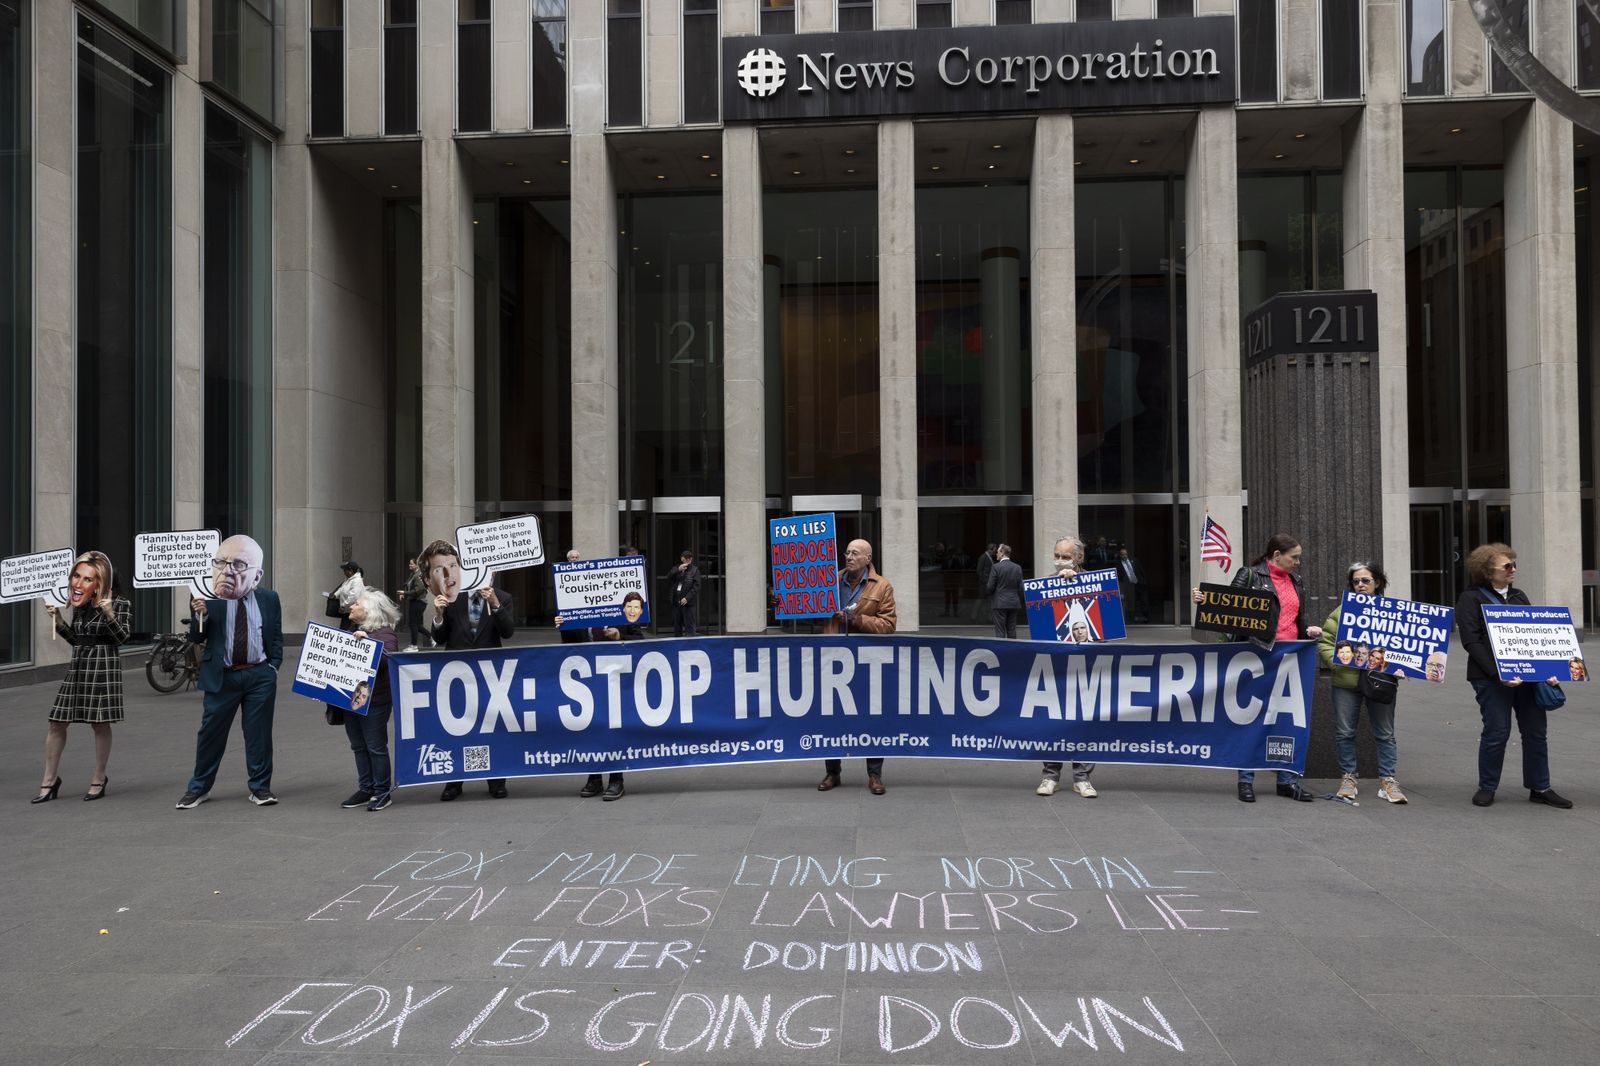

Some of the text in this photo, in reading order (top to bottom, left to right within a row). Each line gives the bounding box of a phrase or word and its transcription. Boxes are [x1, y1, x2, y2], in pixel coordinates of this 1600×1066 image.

[797, 38, 1221, 95] News Corporation
[1292, 305, 1364, 344] 1211
[485, 534, 500, 542] able
[509, 529, 532, 539] ignore
[499, 522, 516, 531] close
[775, 521, 827, 538] FOX LIES
[148, 542, 207, 553] disgusted by
[467, 544, 496, 554] Trump
[512, 538, 532, 547] hate
[772, 538, 836, 565] MURDOCH
[18, 557, 44, 566] serious
[45, 552, 70, 562] lawyer
[142, 554, 173, 562] Trump
[179, 559, 207, 568] scared
[463, 557, 480, 566] him
[554, 558, 643, 571] Tucker's producer:
[2, 560, 70, 577] could believe what
[560, 568, 638, 584] [Our viewers are]
[774, 564, 837, 590] POISONS
[12, 584, 31, 592] were
[1024, 580, 1045, 591] FOX
[1080, 571, 1116, 583] WHITE
[1040, 583, 1102, 599] TERRORISM
[776, 590, 838, 615] AMERICA
[1200, 591, 1270, 612] JUSTICE
[1347, 592, 1450, 618] FOX is SILENT
[1200, 612, 1268, 630] MATTERS
[1362, 607, 1430, 625] about the
[1485, 610, 1530, 618] Ingraham's
[1342, 612, 1447, 642] DOMINION
[1515, 626, 1553, 634] Dominion
[310, 638, 368, 663] like an insane
[336, 633, 343, 643] is
[344, 638, 371, 654] acting
[1346, 628, 1439, 655] LAWSUIT
[398, 646, 1307, 740] FOX: STOP HURTING AMERICA
[428, 750, 452, 762] FOX
[524, 734, 1211, 766] http://www.truthtuesdays.org @TruthOverFox http://www.riseandresist.org
[1268, 748, 1291, 756] RESIST
[423, 761, 453, 776] LIES
[373, 851, 514, 881] FOX
[528, 852, 698, 885] MADE
[733, 854, 893, 887] LYING
[942, 856, 1188, 888] NORMAL
[305, 884, 507, 921] EVEN
[750, 891, 1078, 933] LAWYERS
[1106, 893, 1229, 931] LIE
[492, 938, 983, 973] ENTER: DOMINION
[225, 982, 1184, 1052] FOX IS GOING DOWN
